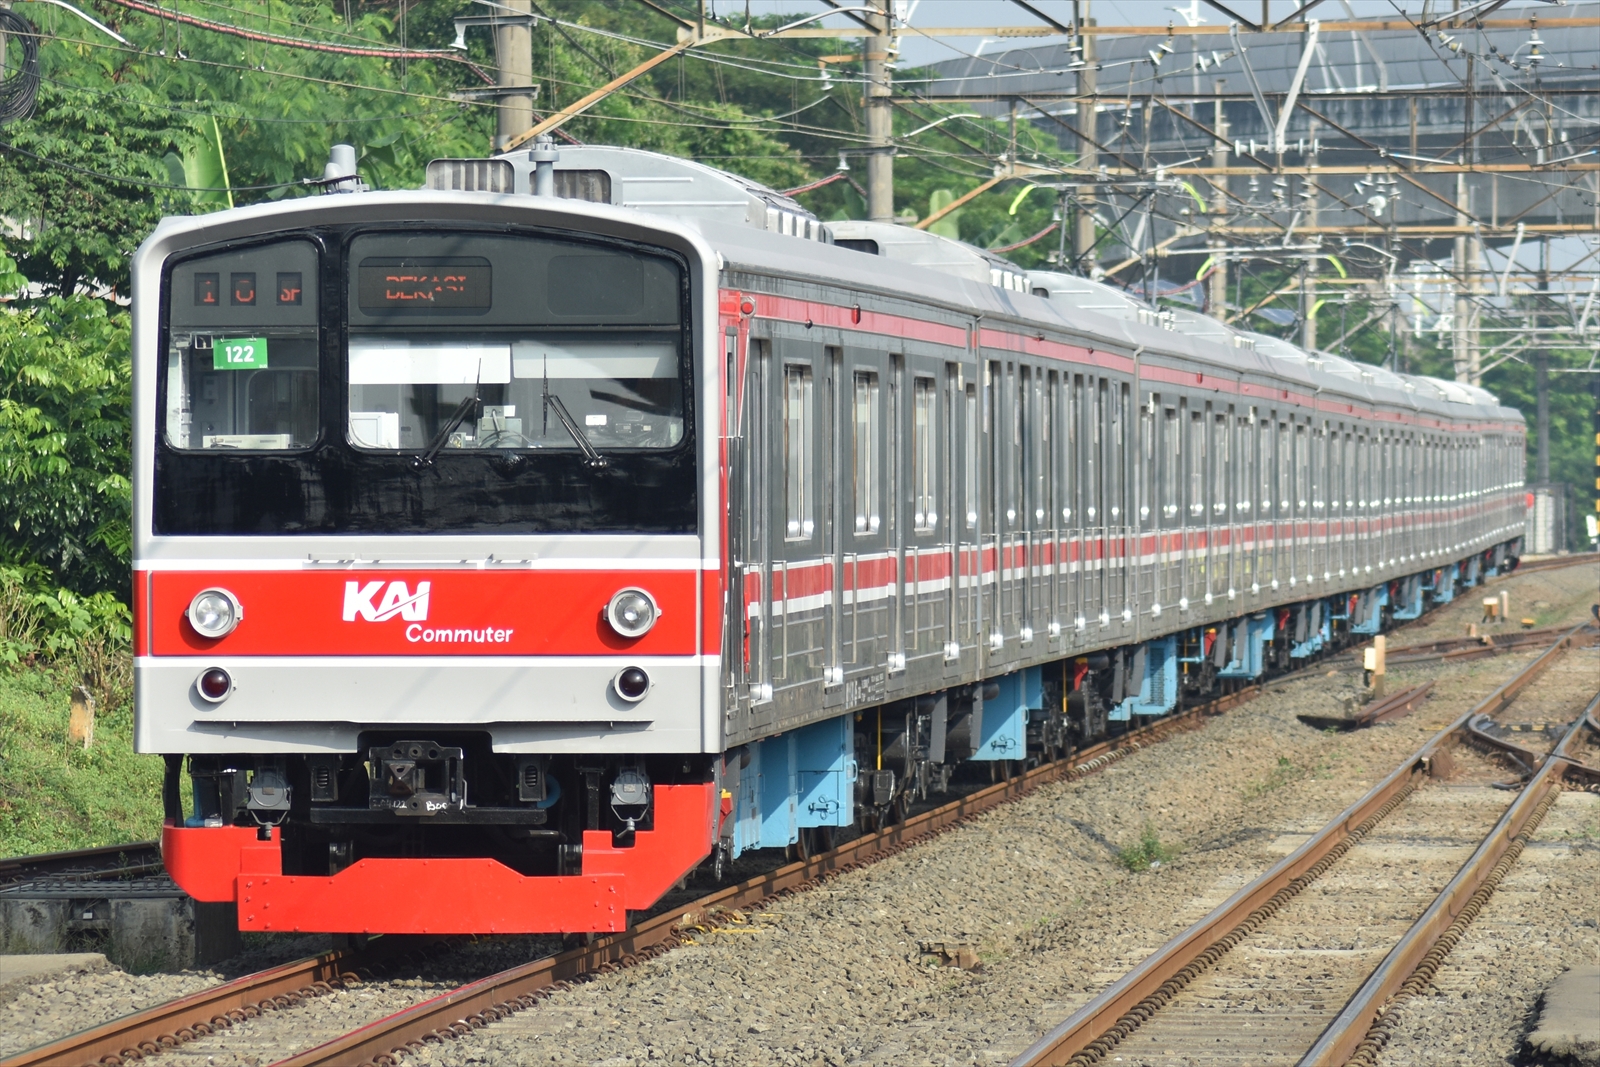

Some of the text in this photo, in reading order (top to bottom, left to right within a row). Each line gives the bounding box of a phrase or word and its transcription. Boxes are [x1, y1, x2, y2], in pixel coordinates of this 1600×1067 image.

[225, 345, 255, 363] 122
[342, 580, 431, 622] KAI
[405, 623, 514, 643] Commuter
